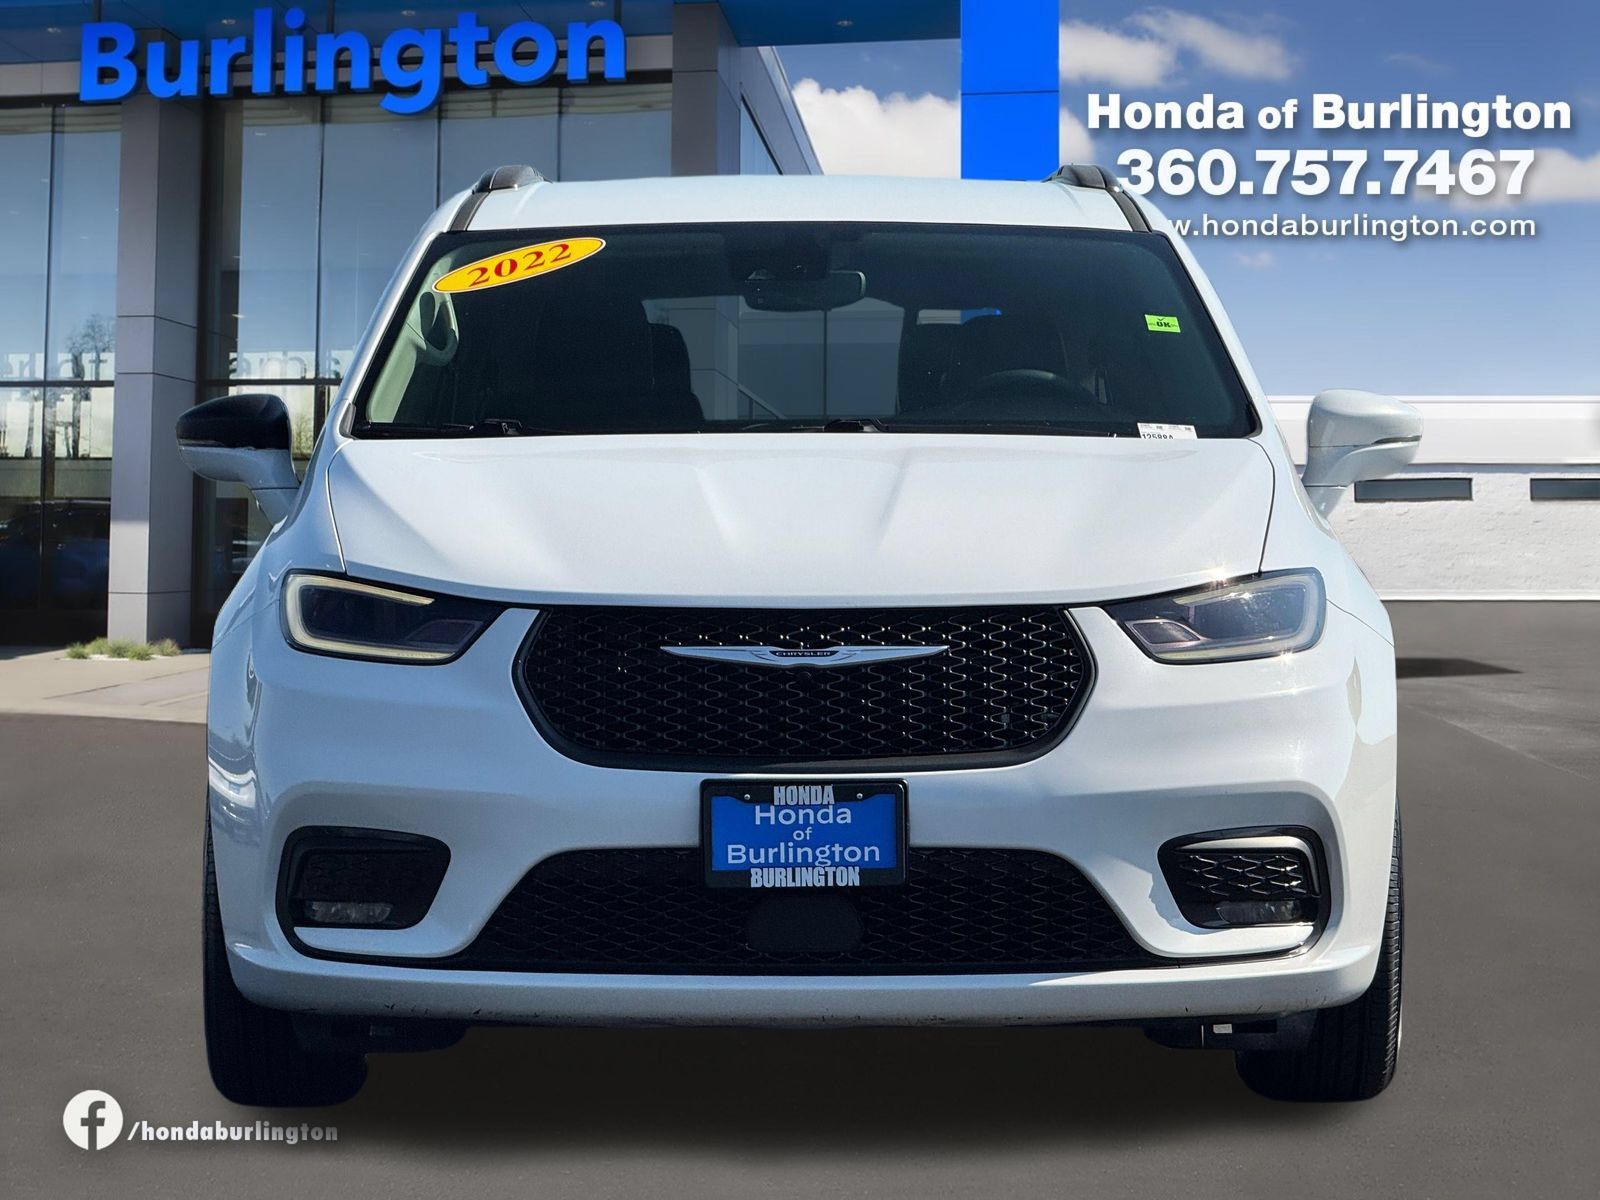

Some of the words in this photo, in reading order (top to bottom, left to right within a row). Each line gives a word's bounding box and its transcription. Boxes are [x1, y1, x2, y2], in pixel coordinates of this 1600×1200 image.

[79, 7, 627, 115] Burlington
[467, 243, 572, 288] 2022
[773, 784, 835, 806] HONDA
[755, 805, 852, 825] Honda
[792, 827, 813, 841] of
[727, 842, 880, 867] Burlington
[750, 866, 860, 888] BURLINGTON
